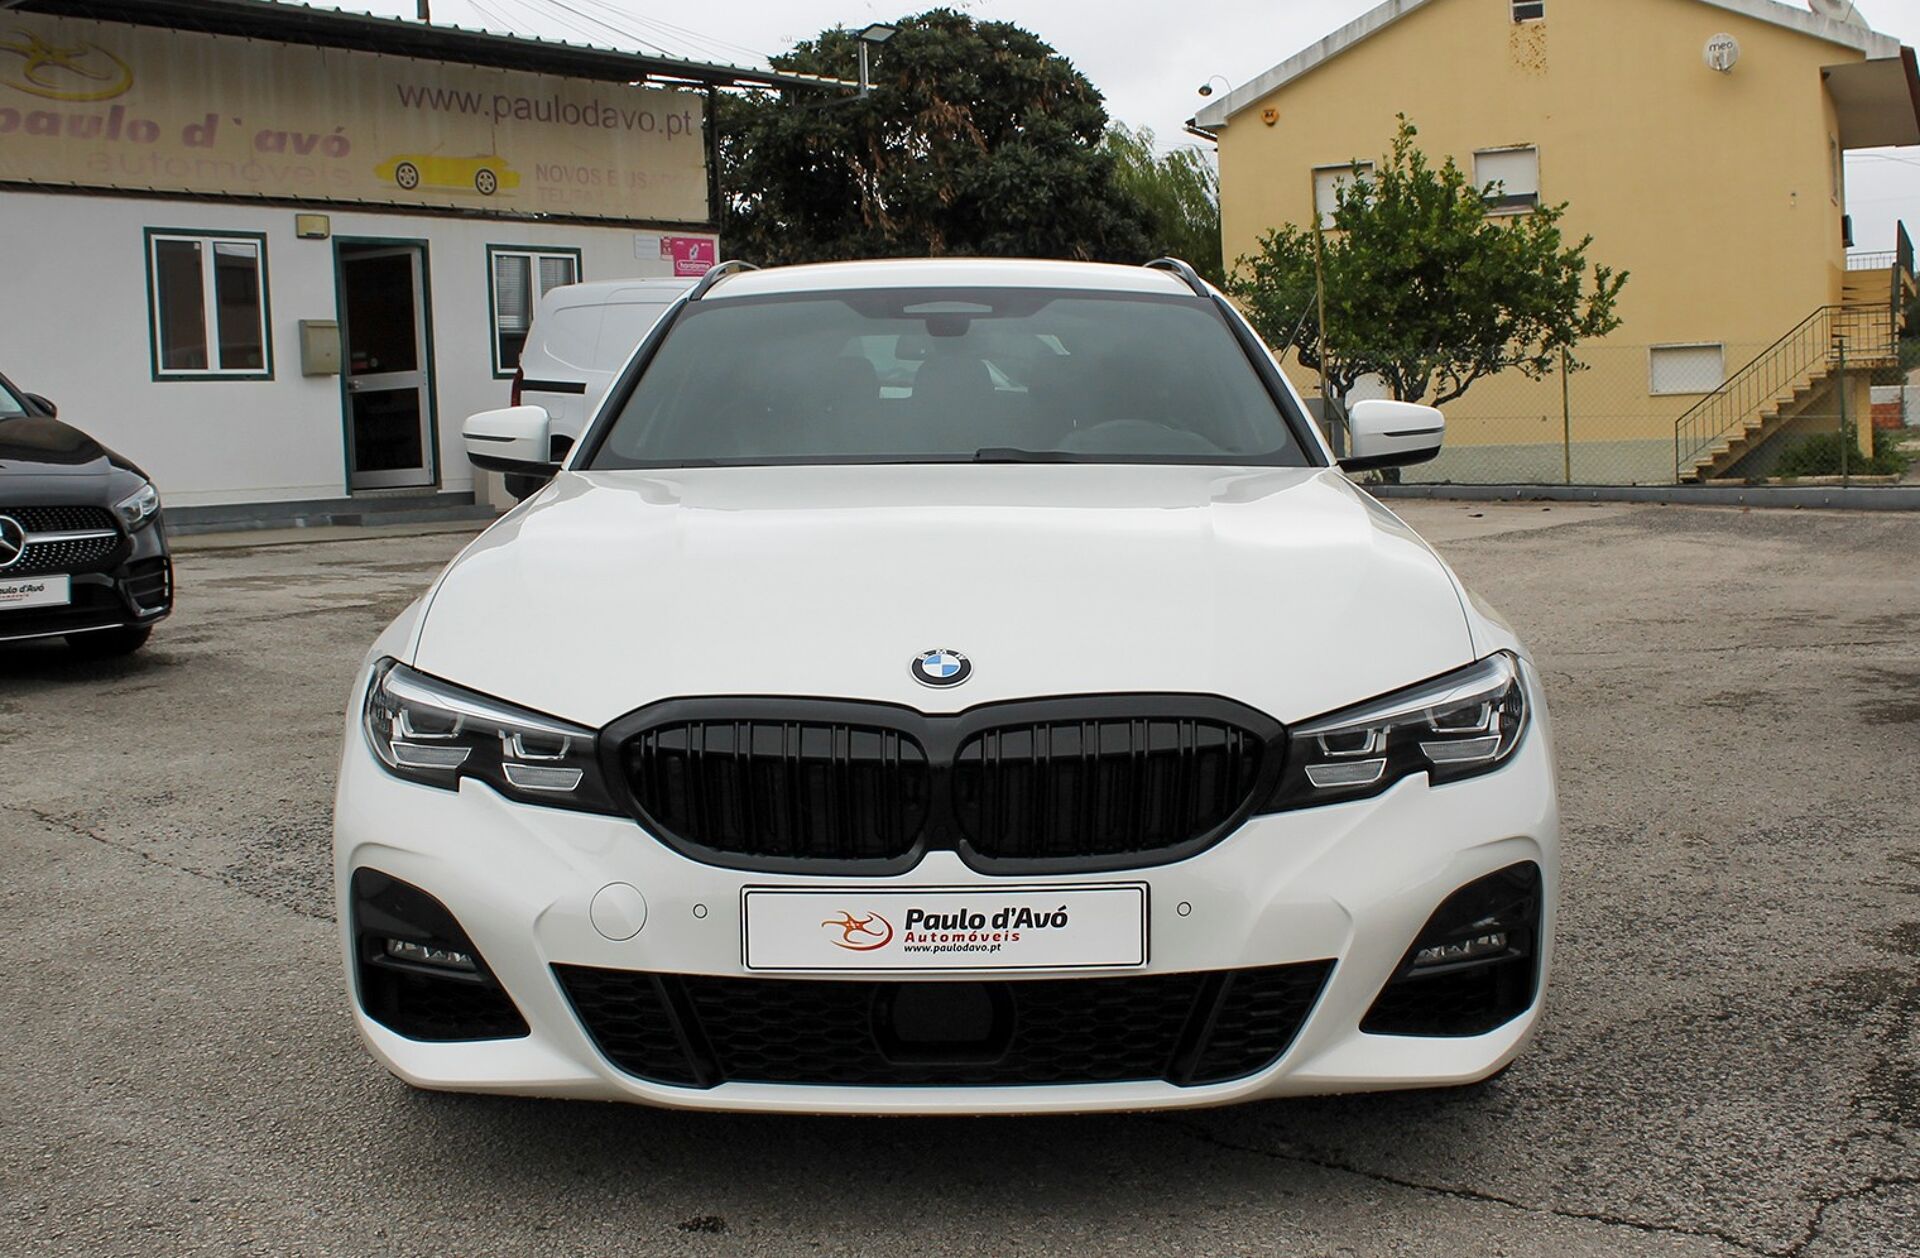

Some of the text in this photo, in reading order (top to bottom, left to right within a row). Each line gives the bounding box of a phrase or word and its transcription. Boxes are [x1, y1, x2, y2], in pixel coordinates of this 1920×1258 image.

[1708, 41, 1733, 51] meo
[397, 84, 692, 140] www.paulodavo.pt
[535, 163, 602, 186] NOVOS
[905, 904, 1068, 931] Paulo d'Avó
[904, 930, 1020, 943] Automóveis
[904, 943, 1001, 954] www.paulodavo.pt
